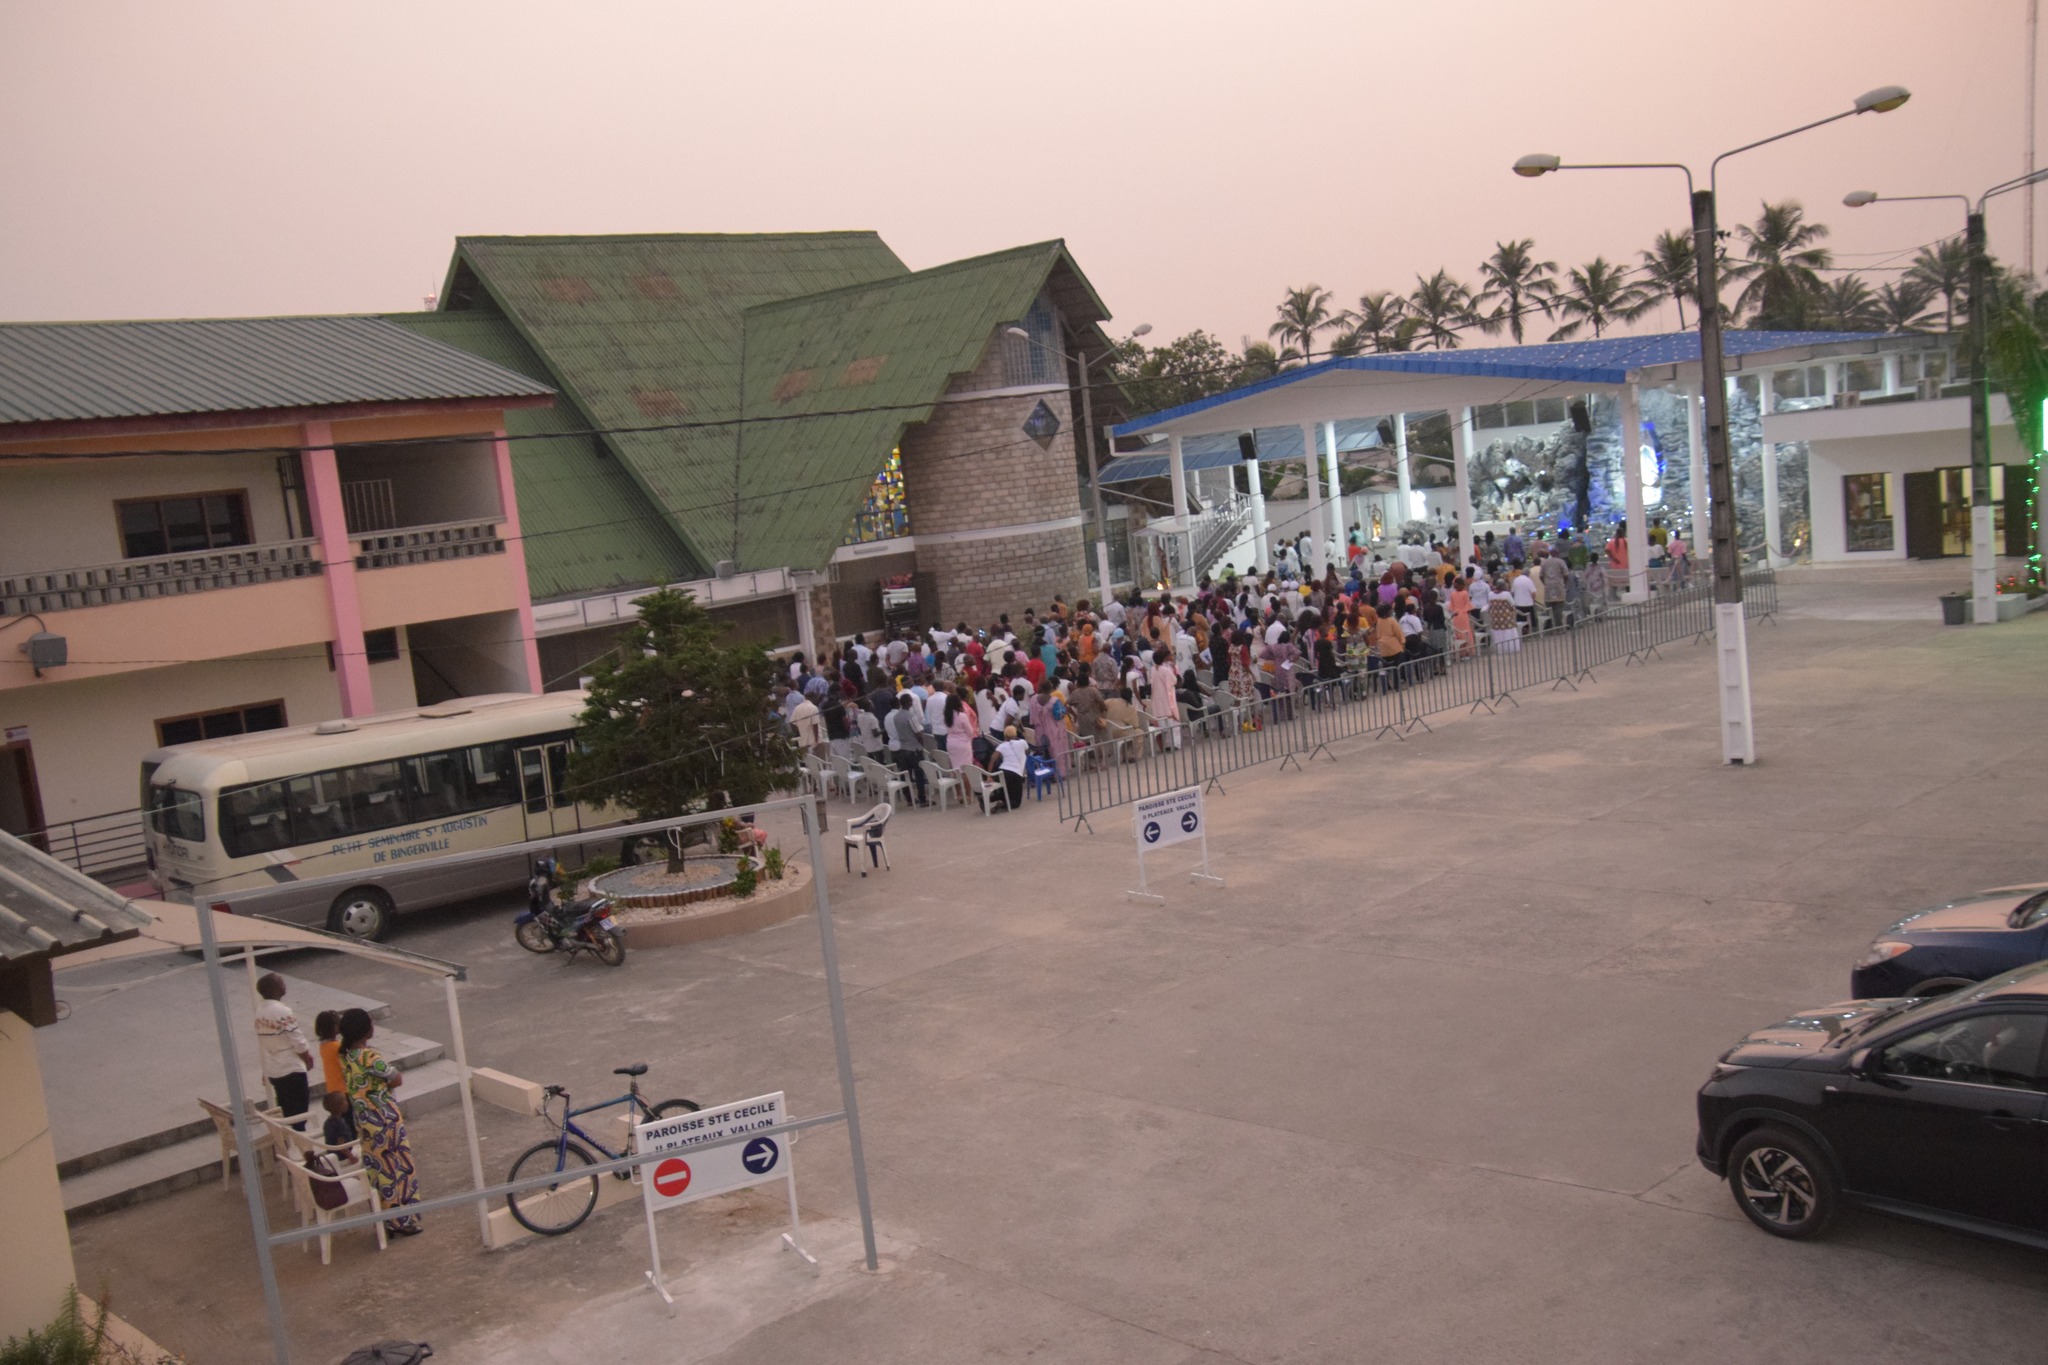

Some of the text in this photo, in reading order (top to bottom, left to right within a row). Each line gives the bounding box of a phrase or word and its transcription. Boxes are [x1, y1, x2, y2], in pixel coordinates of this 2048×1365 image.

[1138, 801, 1164, 811] PAROISSE
[1178, 793, 1196, 802] CECILE
[1148, 808, 1173, 818] PLATEAUX
[1176, 802, 1196, 811] VALLON
[332, 841, 362, 855] PETIT
[368, 829, 422, 848] SEMINAIRE
[441, 816, 488, 833] AUGUSTIN
[374, 838, 449, 863] DE BINGERVILLE
[646, 1102, 775, 1141] PAROISSE STE CECILE
[730, 1118, 773, 1134] VALLON
